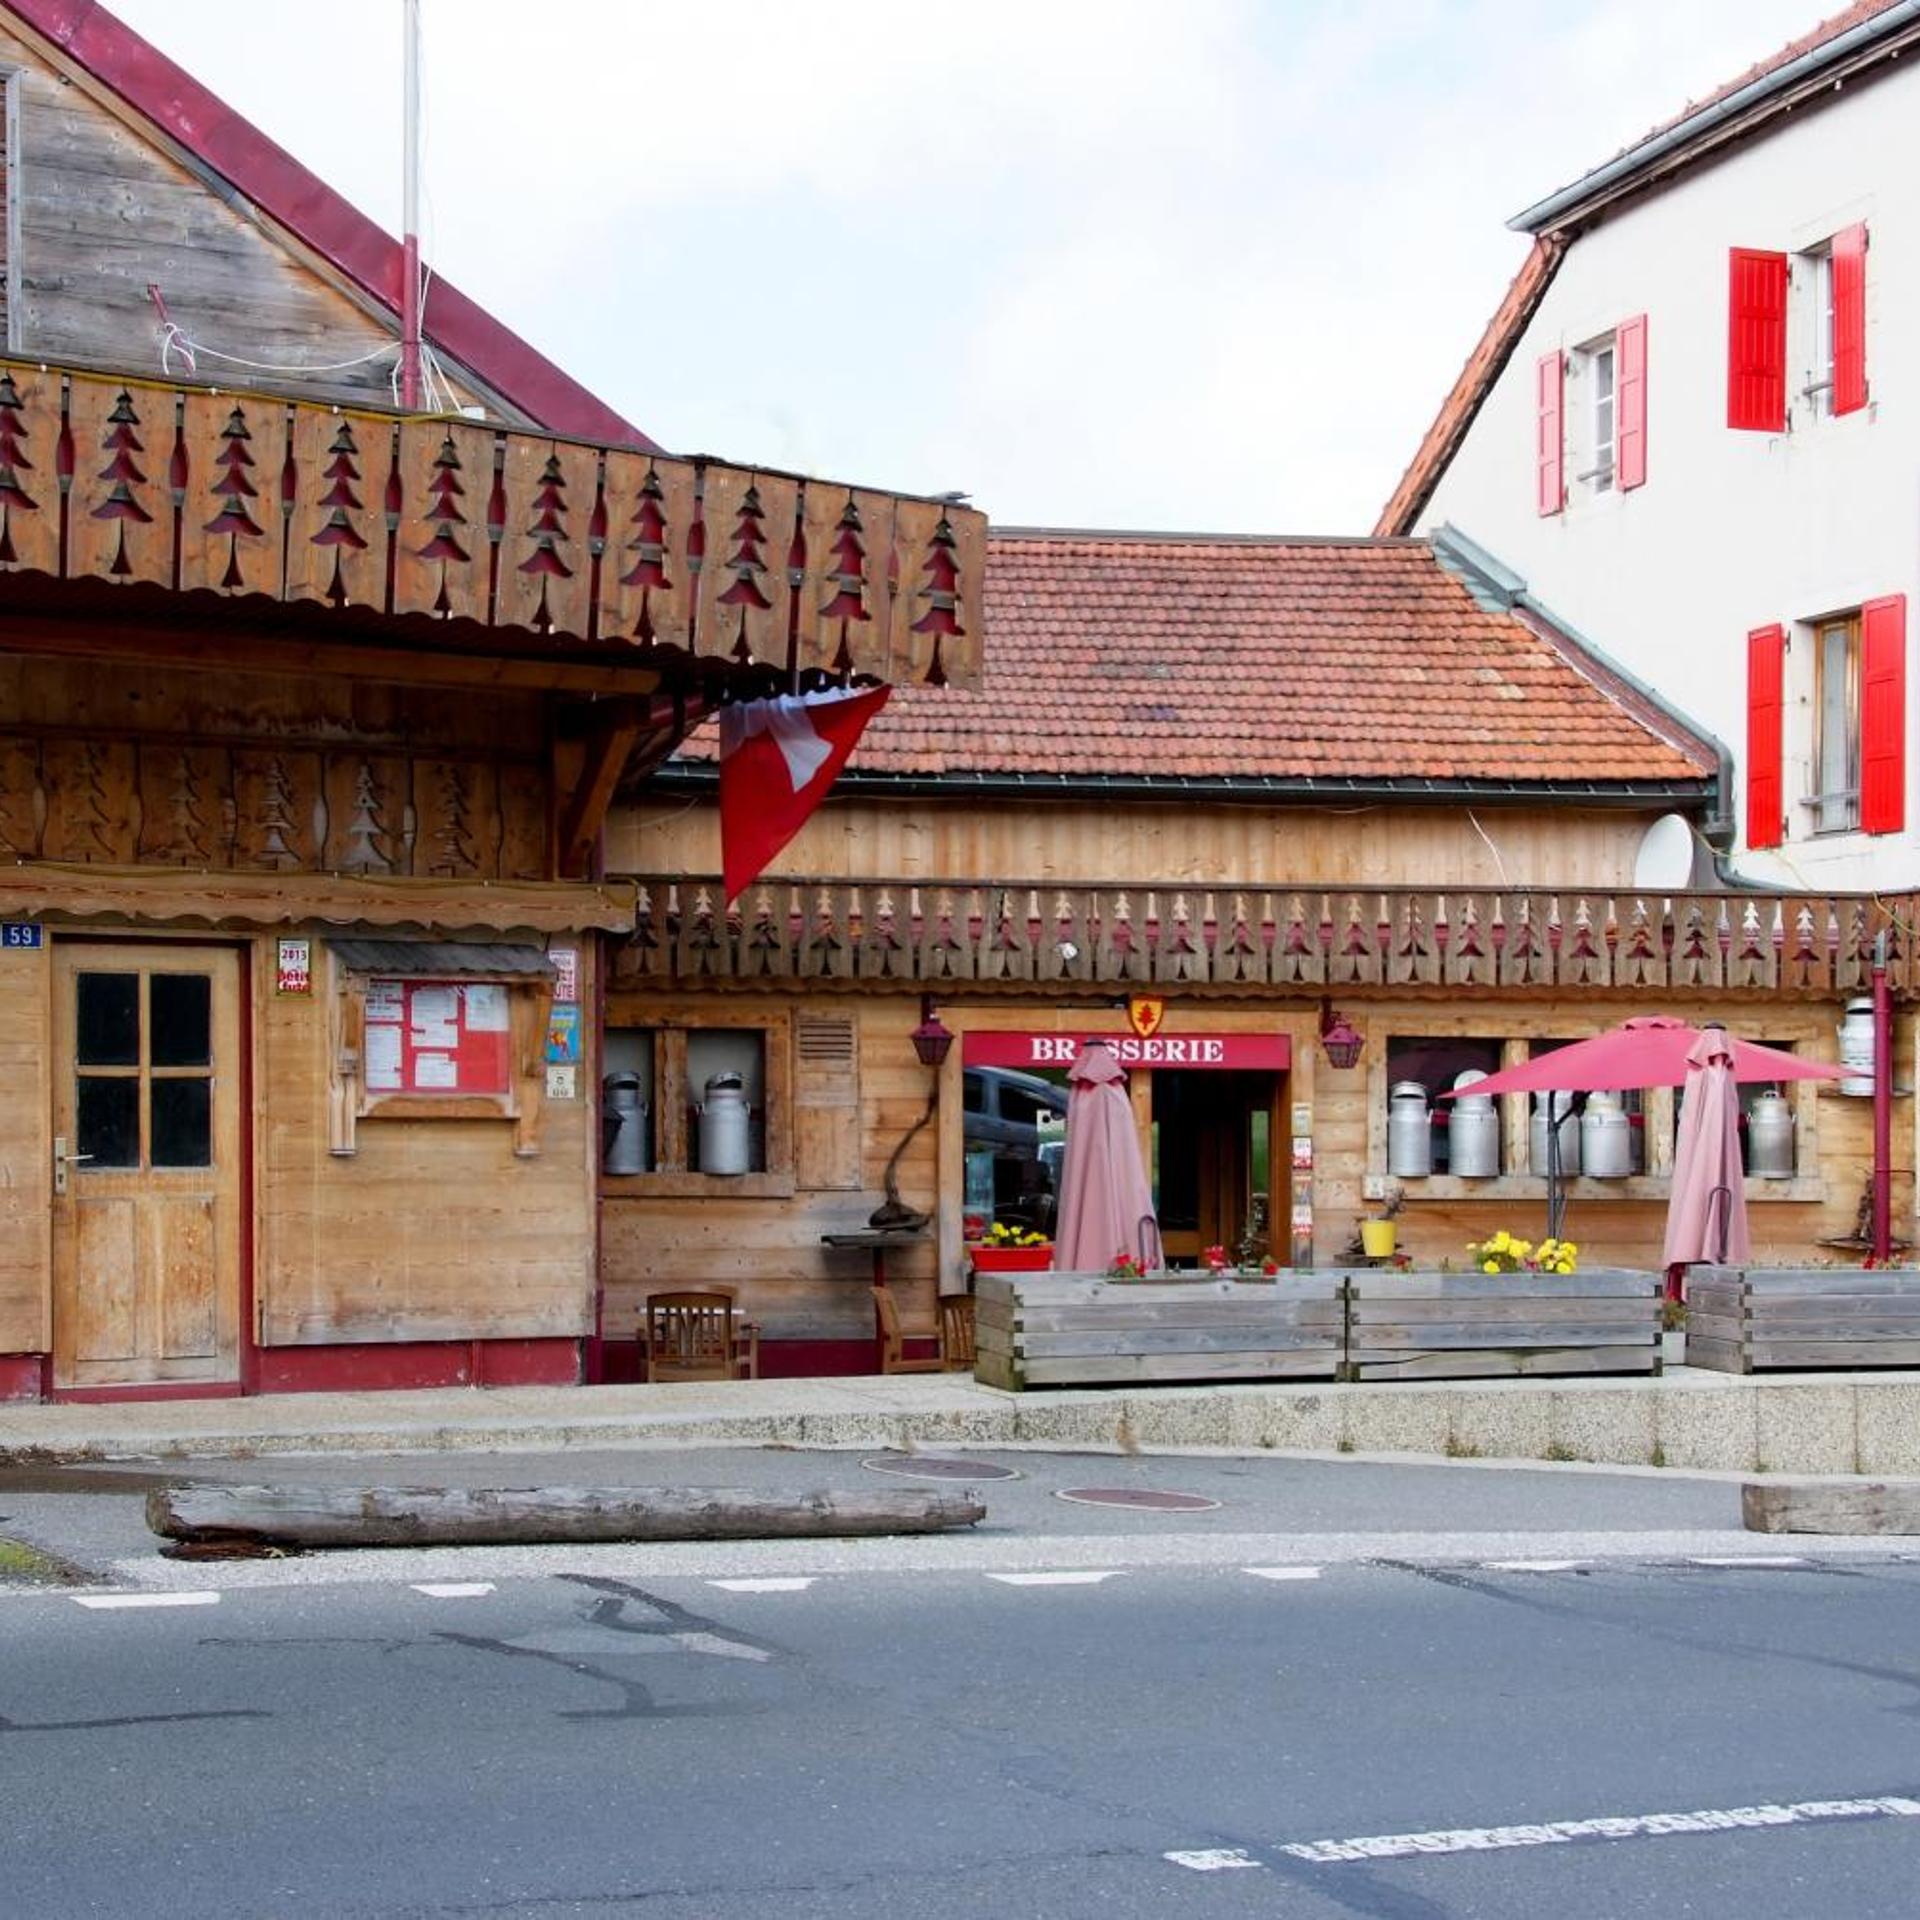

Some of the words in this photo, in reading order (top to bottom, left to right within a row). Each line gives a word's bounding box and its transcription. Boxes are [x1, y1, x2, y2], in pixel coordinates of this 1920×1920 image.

[10, 926, 32, 945] 59
[281, 948, 307, 961] 2013
[1031, 1037, 1224, 1062] BRSSERIE
